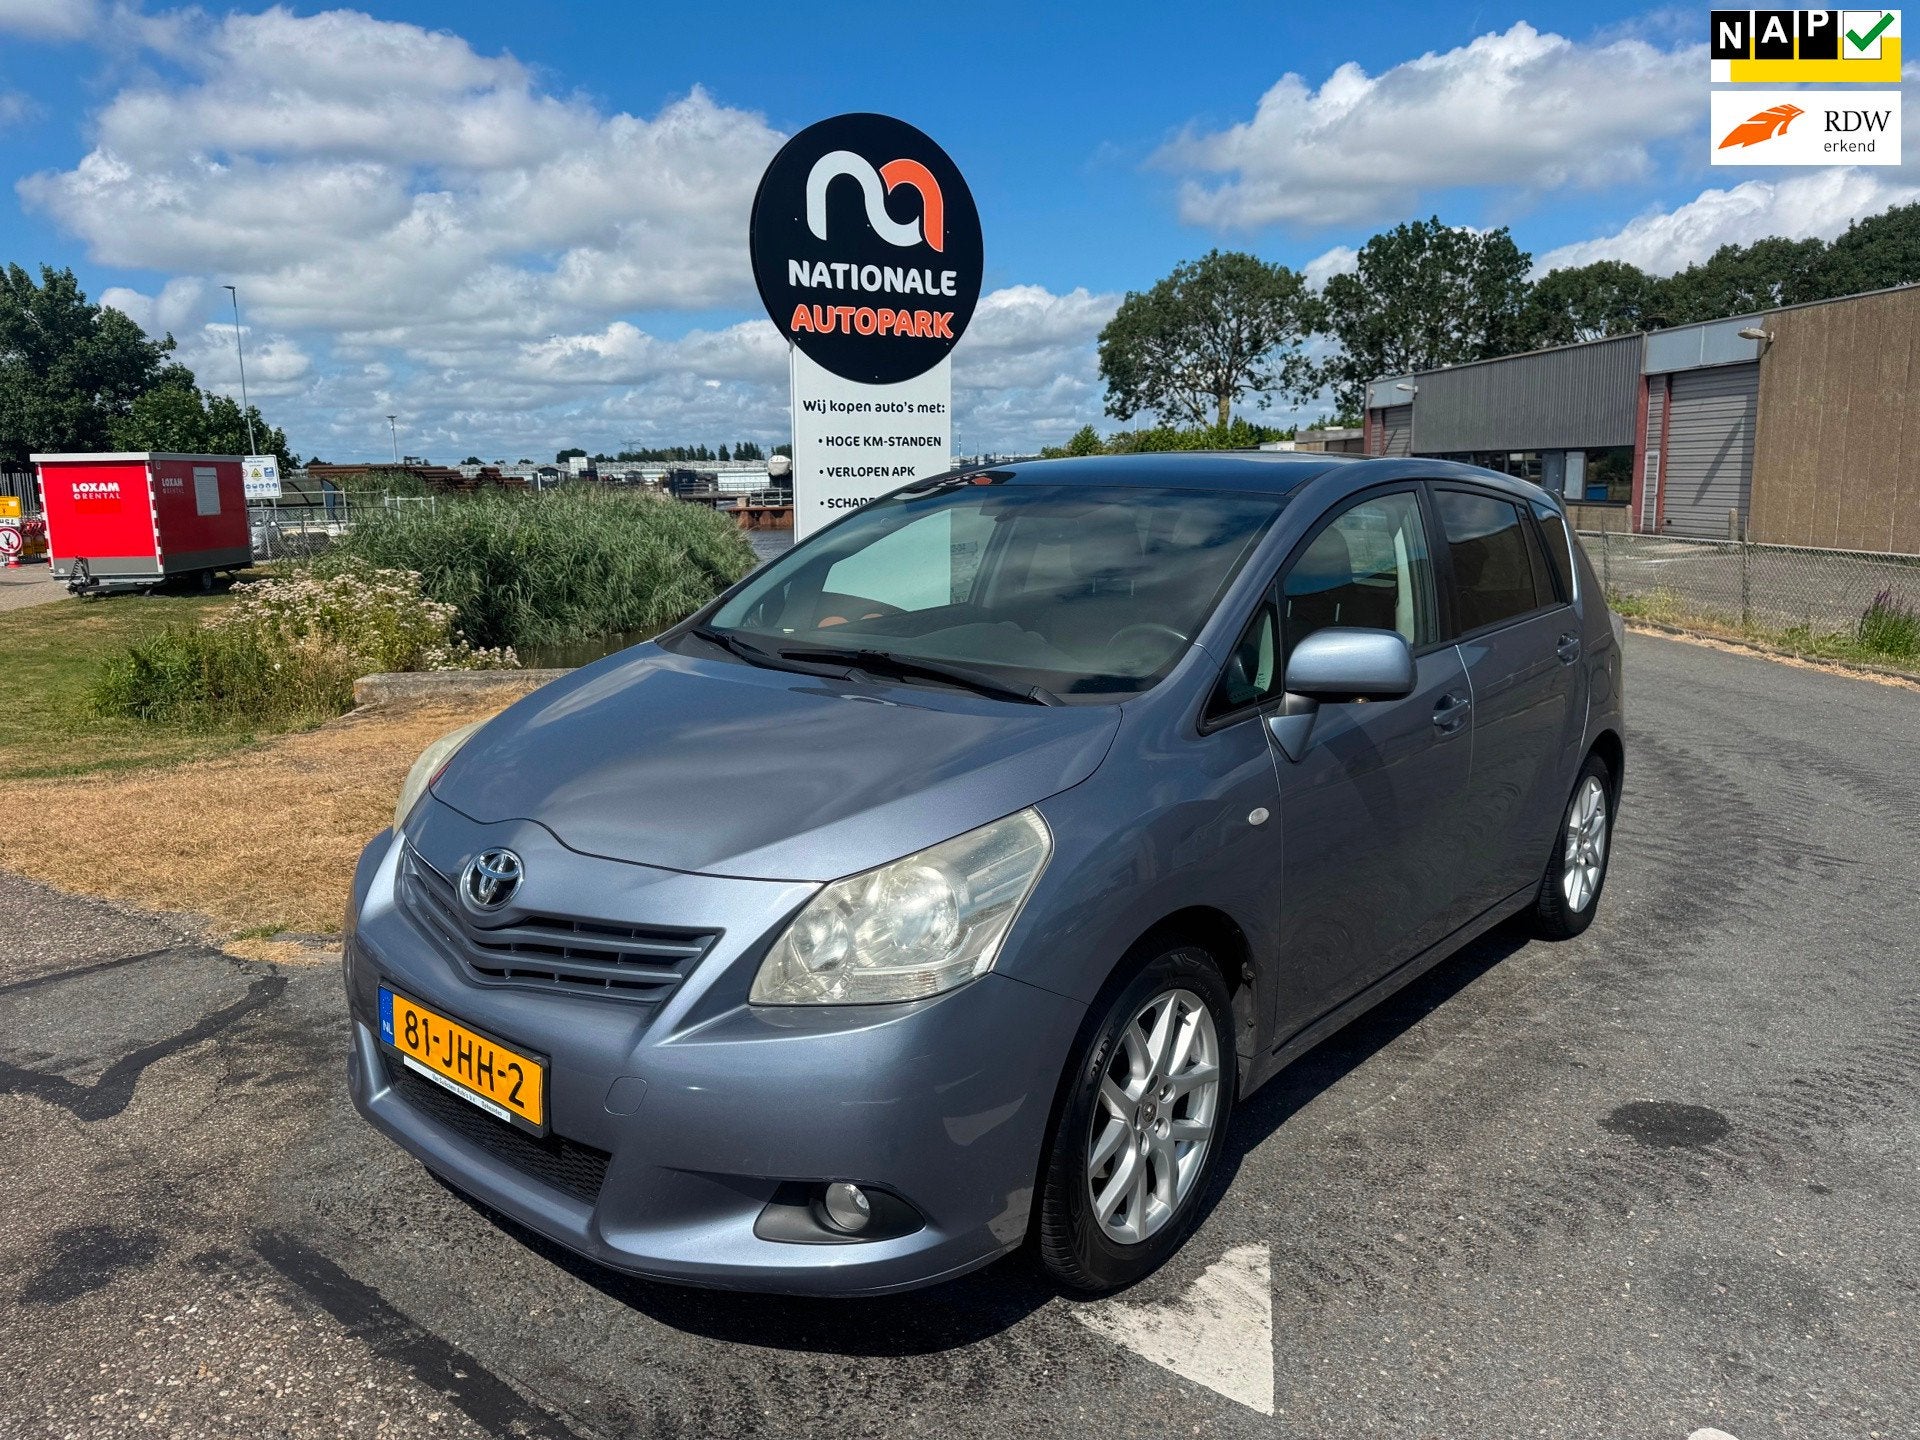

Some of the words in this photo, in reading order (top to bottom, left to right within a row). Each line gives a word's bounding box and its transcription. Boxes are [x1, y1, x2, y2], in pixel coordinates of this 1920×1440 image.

[788, 259, 957, 296] NATIONALE
[790, 304, 954, 338] AUTOPARK
[803, 399, 826, 414] Wij
[829, 400, 871, 414] kopen
[875, 401, 914, 413] auto's
[917, 403, 945, 413] met:
[826, 436, 860, 446] HOGE
[863, 436, 942, 446] KM-STANDEN
[827, 467, 889, 477] VERLOPEN
[892, 466, 915, 476] APK
[72, 482, 120, 492] LOXAM
[382, 1020, 393, 1035] NL
[405, 1010, 525, 1109] 81-JHH-2
